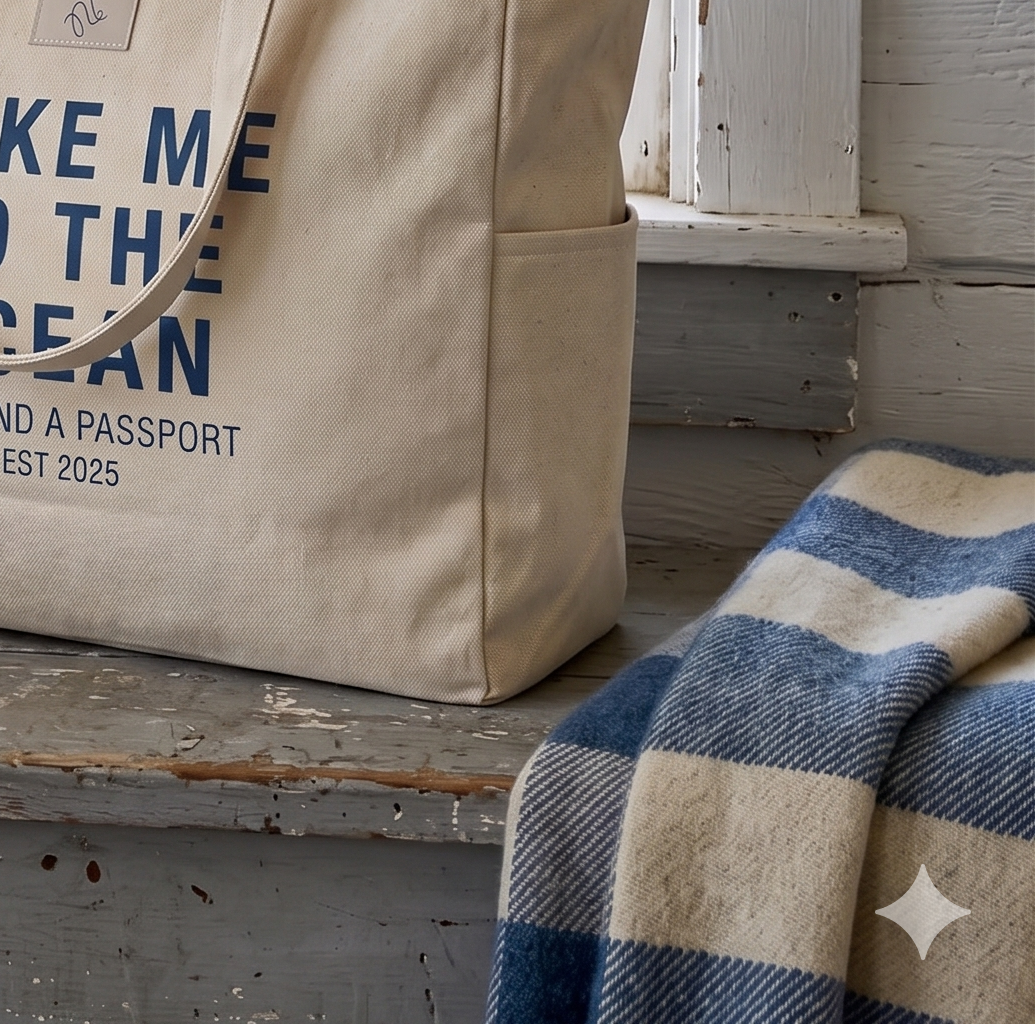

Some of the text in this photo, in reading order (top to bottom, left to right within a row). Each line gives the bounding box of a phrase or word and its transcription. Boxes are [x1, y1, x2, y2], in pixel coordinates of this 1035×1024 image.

[142, 106, 277, 193] ME
[44, 407, 66, 439] A
[77, 409, 241, 457] PASSPORT
[2, 448, 120, 487] EST 2025
